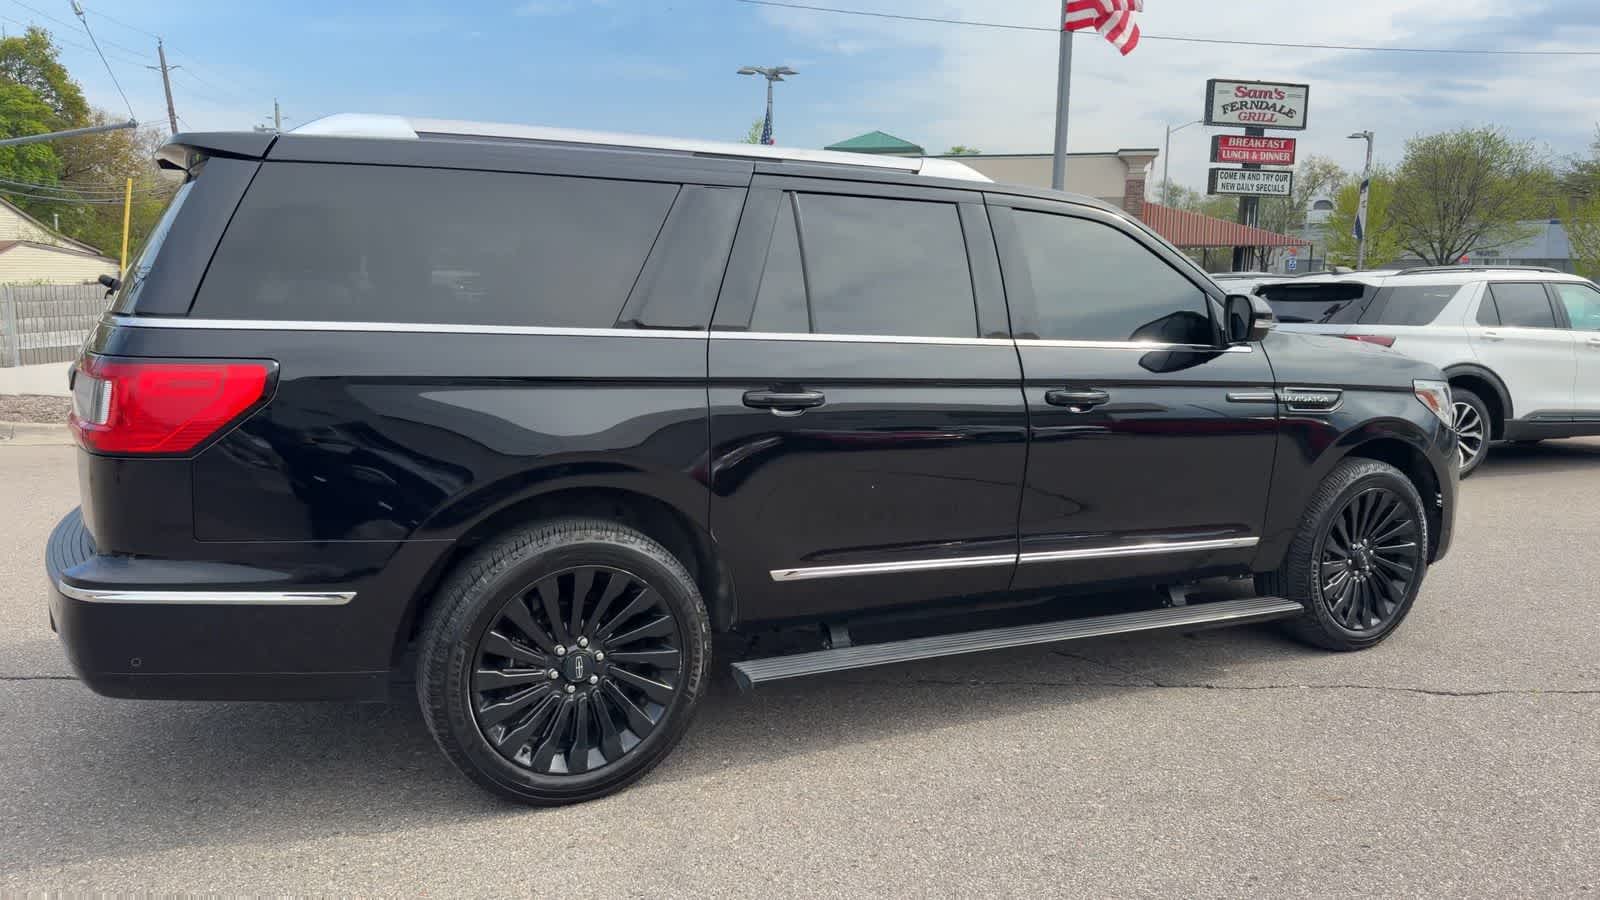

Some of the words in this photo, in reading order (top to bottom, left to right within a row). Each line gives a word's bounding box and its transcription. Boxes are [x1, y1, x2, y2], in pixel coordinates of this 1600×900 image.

[1235, 85, 1286, 100] Sam's
[1221, 100, 1297, 119] FERNDALE
[1238, 111, 1278, 123] GRILL
[1228, 138, 1286, 149] BREAKFAST
[1222, 150, 1249, 160] LUNCH
[1251, 152, 1258, 160] &
[1260, 151, 1290, 161] DINNER
[1219, 171, 1238, 180] COME
[1239, 172, 1246, 180] IN
[1247, 172, 1261, 181] AND
[1262, 173, 1274, 181] TRY
[1275, 173, 1288, 182] OUR
[1221, 182, 1236, 191] NEW
[1236, 183, 1254, 191] DAILY
[1255, 183, 1285, 193] SPECIALS
